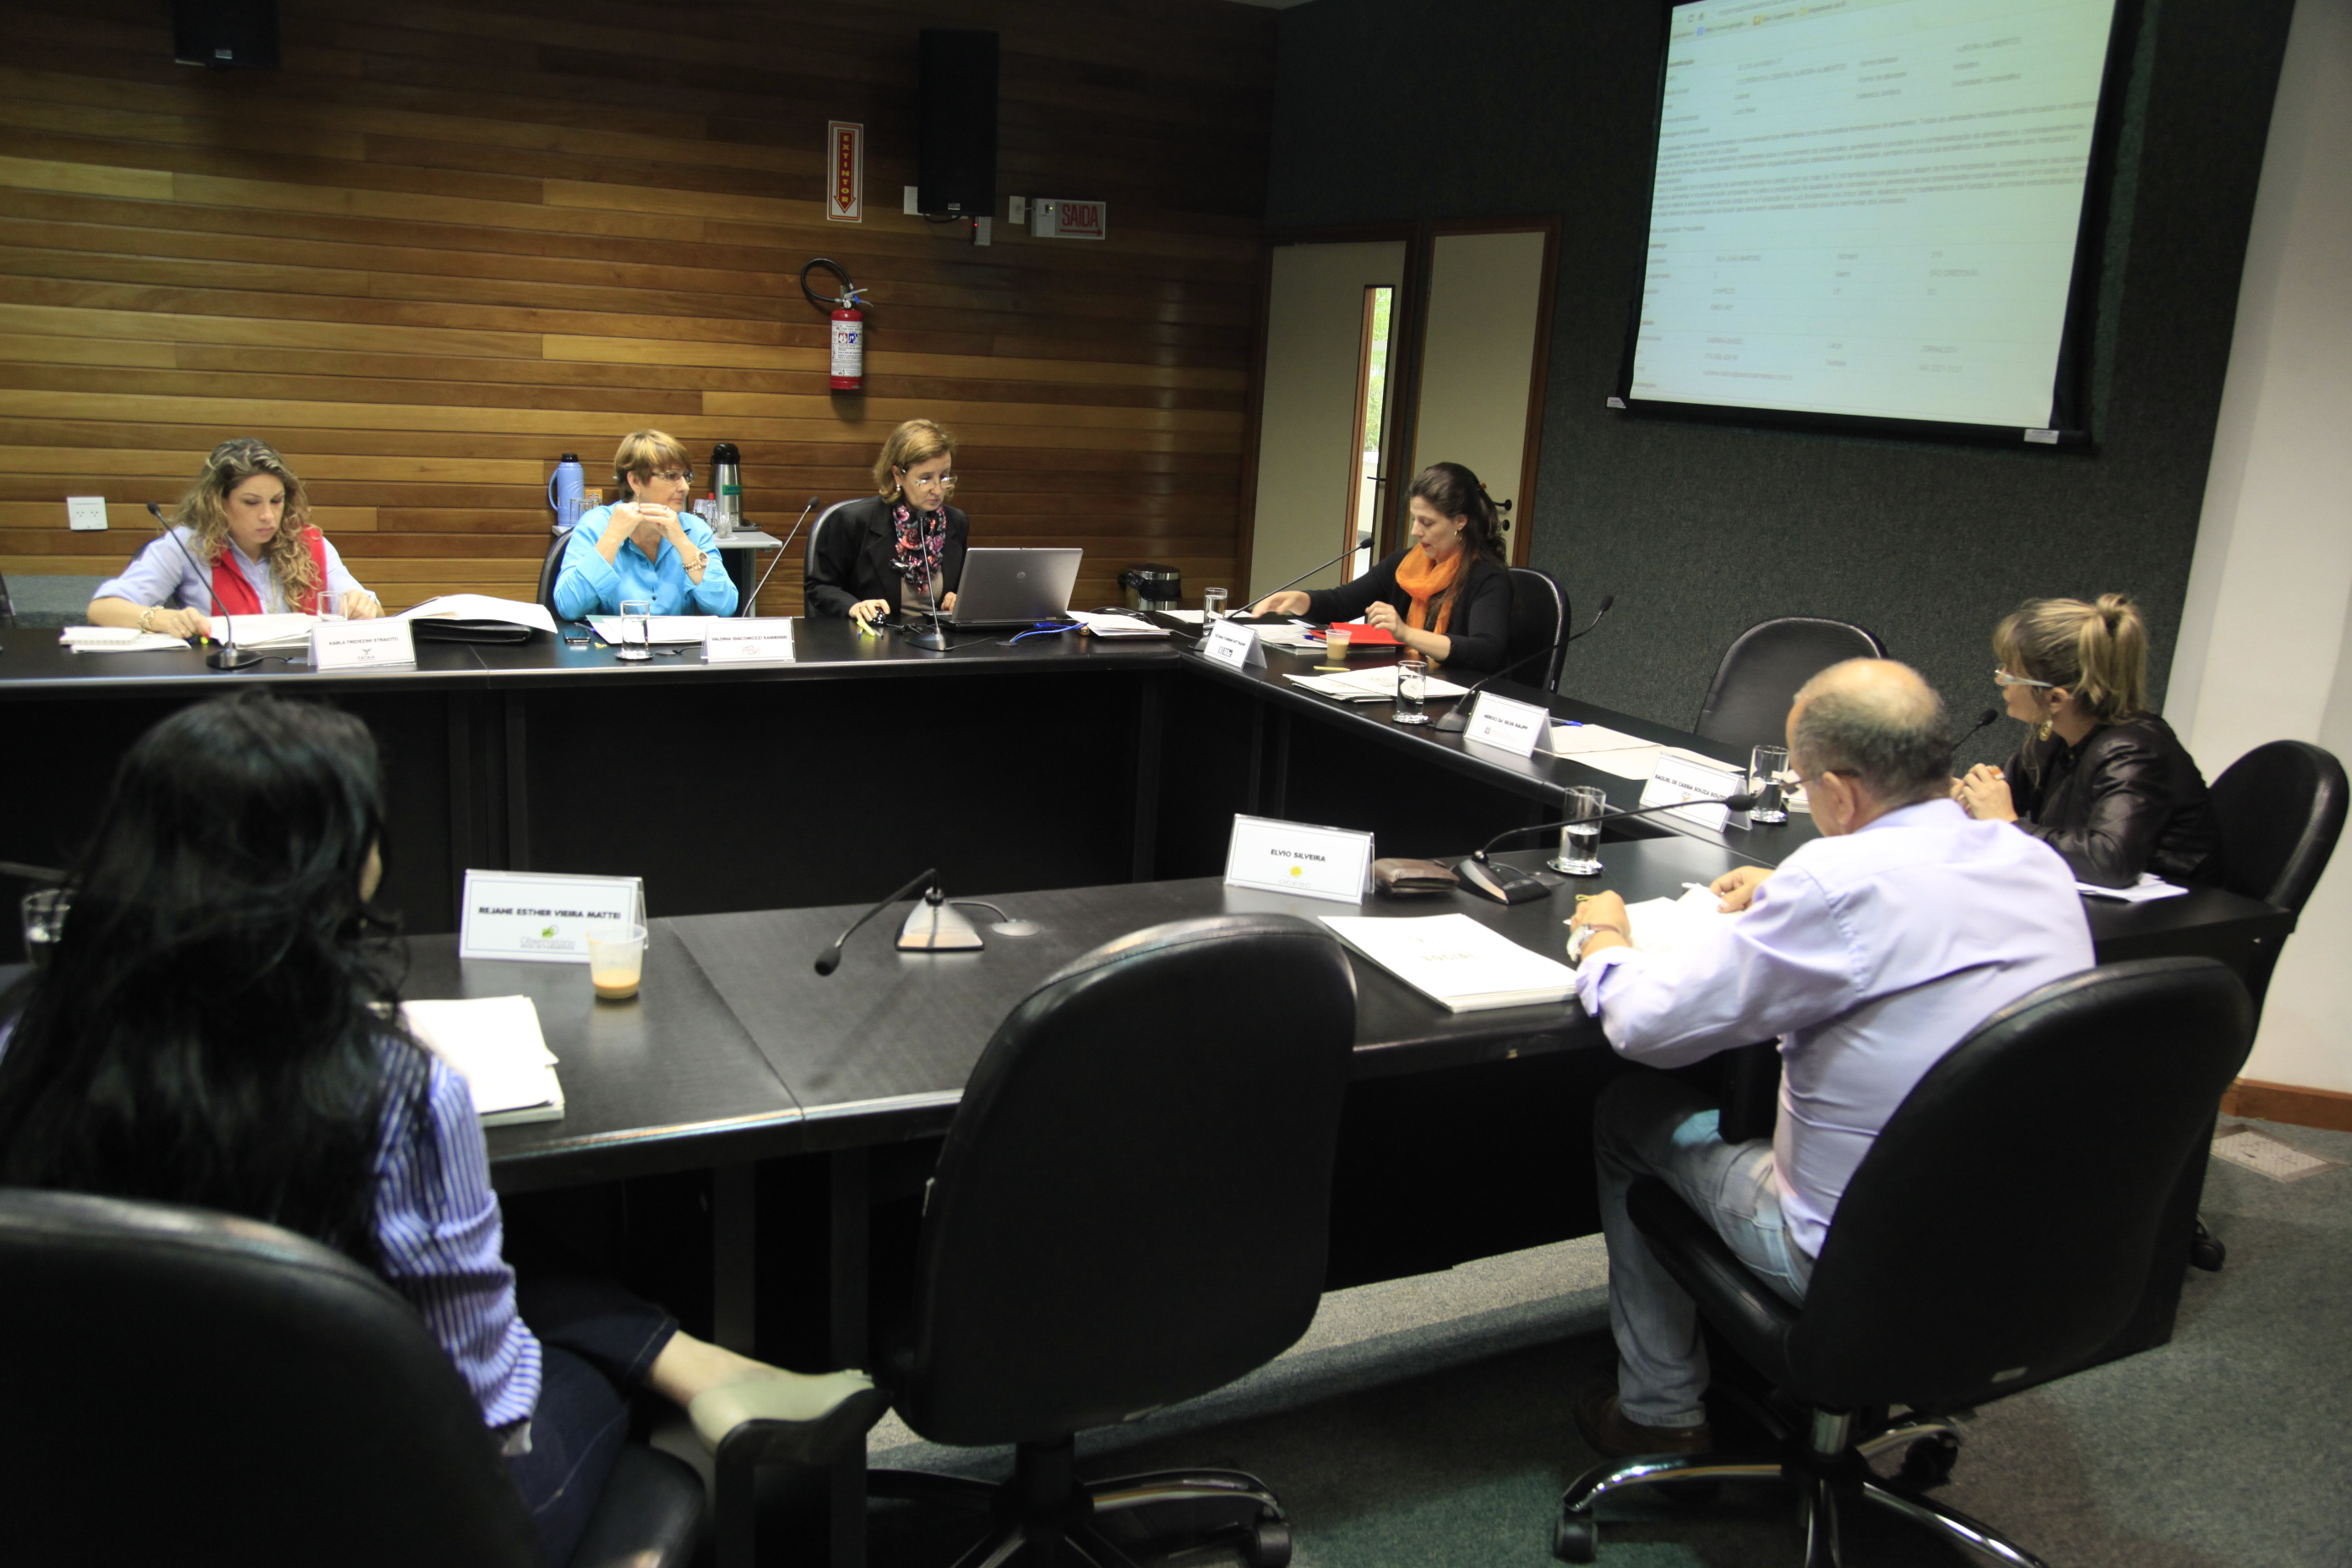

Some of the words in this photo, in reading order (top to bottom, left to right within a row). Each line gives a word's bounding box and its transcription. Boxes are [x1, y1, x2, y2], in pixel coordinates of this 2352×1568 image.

[841, 135, 850, 203] EXTINTOR
[1062, 204, 1098, 227] SAIDA
[1655, 775, 1670, 783] RAQUEL
[1694, 787, 1710, 796] SOUZA
[1271, 848, 1291, 857] ELVIO
[1293, 852, 1326, 862] SILVEIRA
[478, 907, 514, 916] REJANE
[517, 908, 551, 917] ESTHER
[554, 909, 583, 917] VIEIRA
[586, 911, 621, 919] MATTEI
